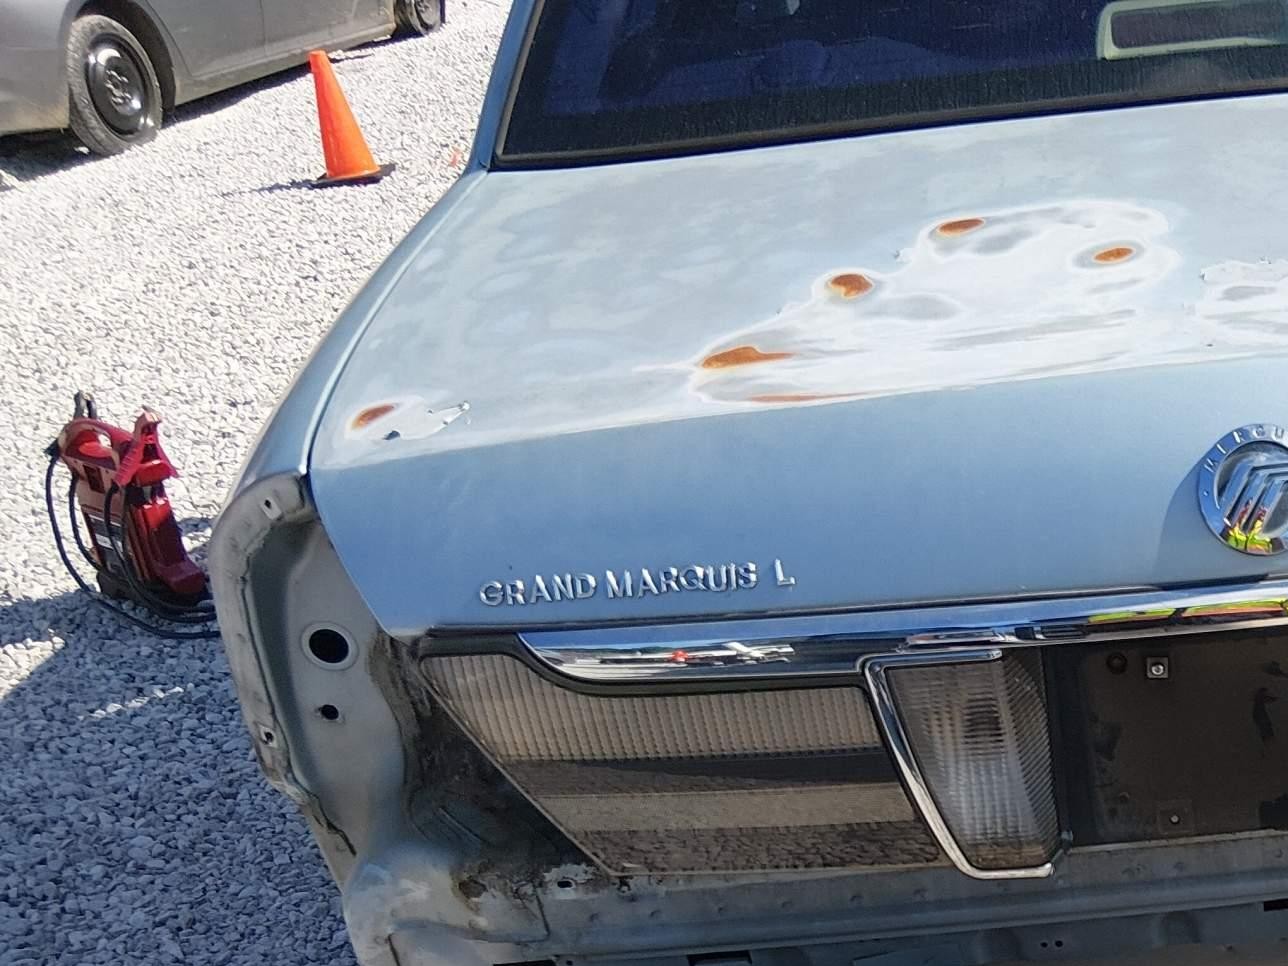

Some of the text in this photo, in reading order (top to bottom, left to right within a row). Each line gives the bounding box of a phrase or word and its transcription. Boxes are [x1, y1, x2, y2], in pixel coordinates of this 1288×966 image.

[479, 558, 797, 607] GRAND MARQUIS L
